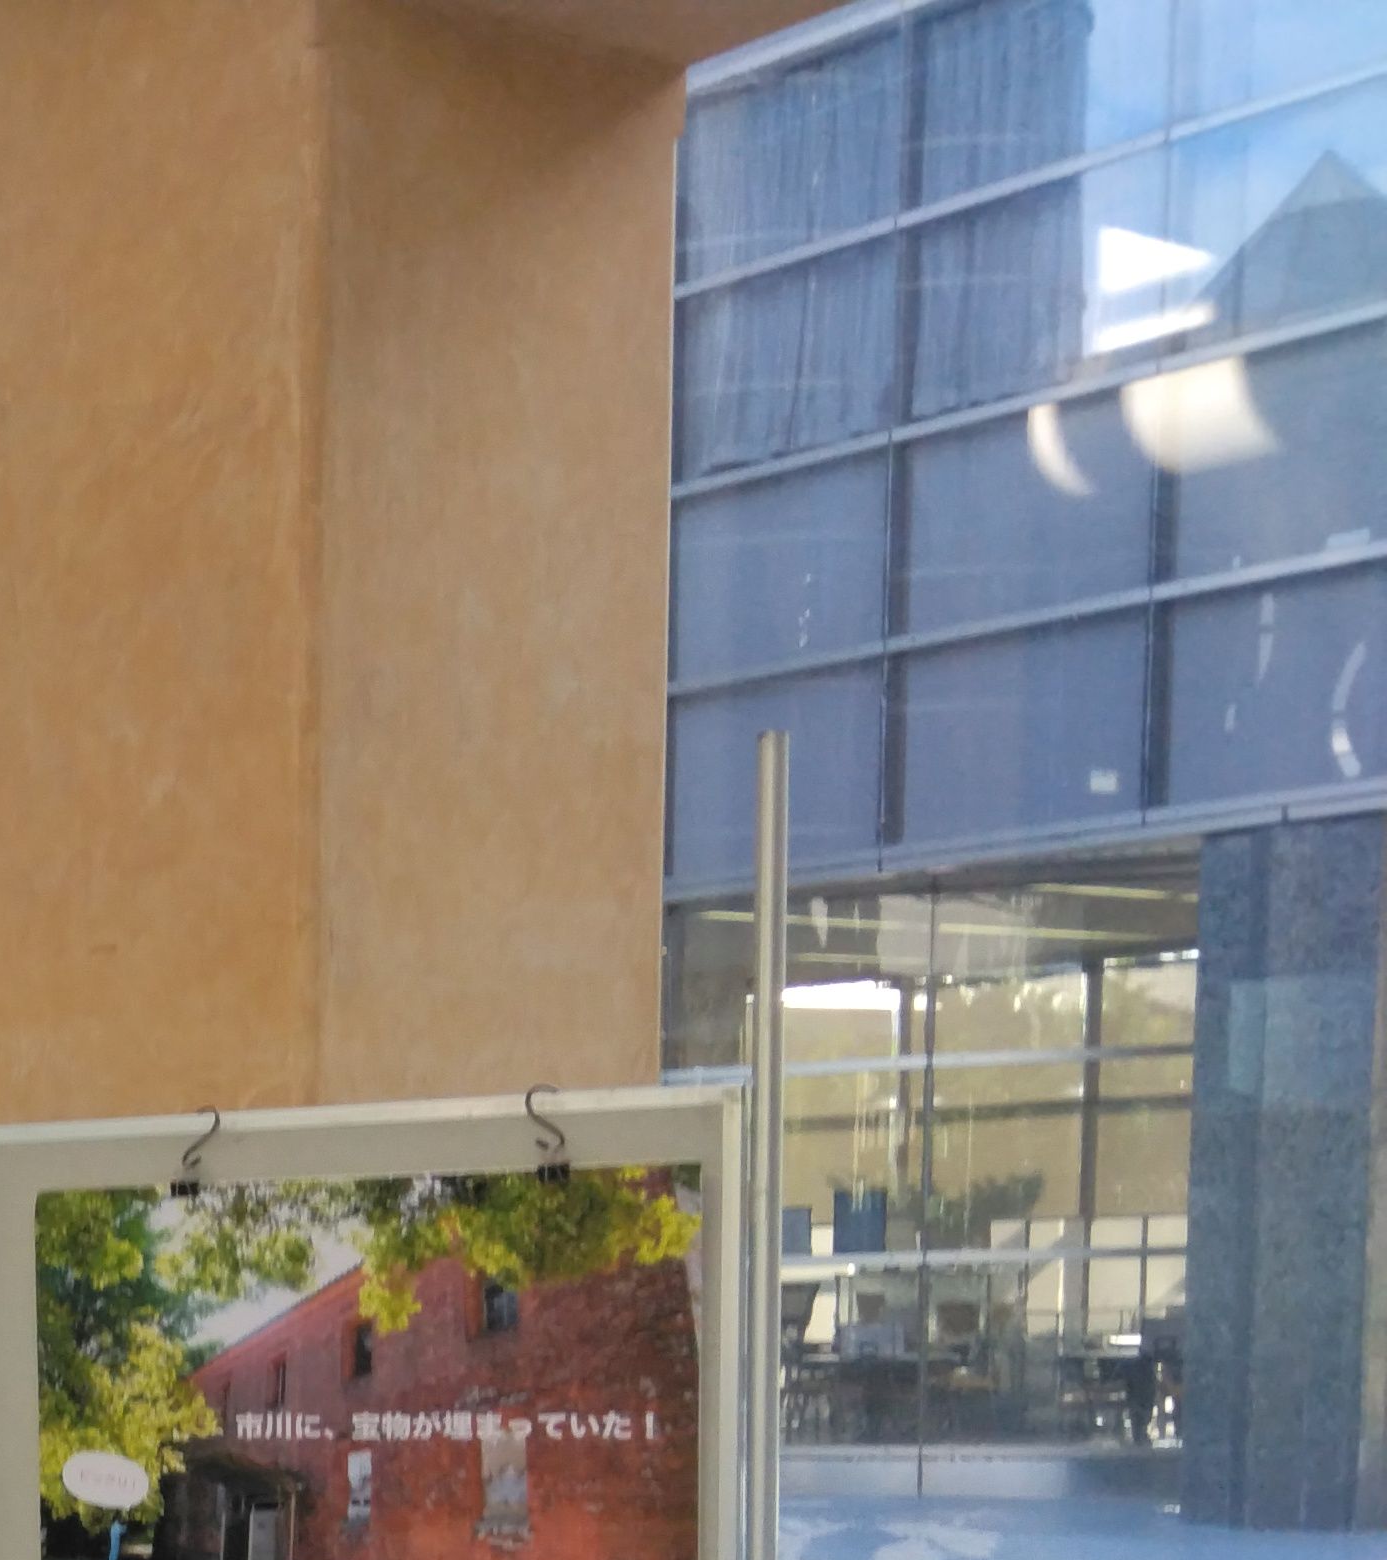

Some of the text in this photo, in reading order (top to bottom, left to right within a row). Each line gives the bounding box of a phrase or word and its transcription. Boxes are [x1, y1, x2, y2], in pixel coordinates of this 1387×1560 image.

[235, 1410, 656, 1441] 市川に、宝物が埋まっていた！
